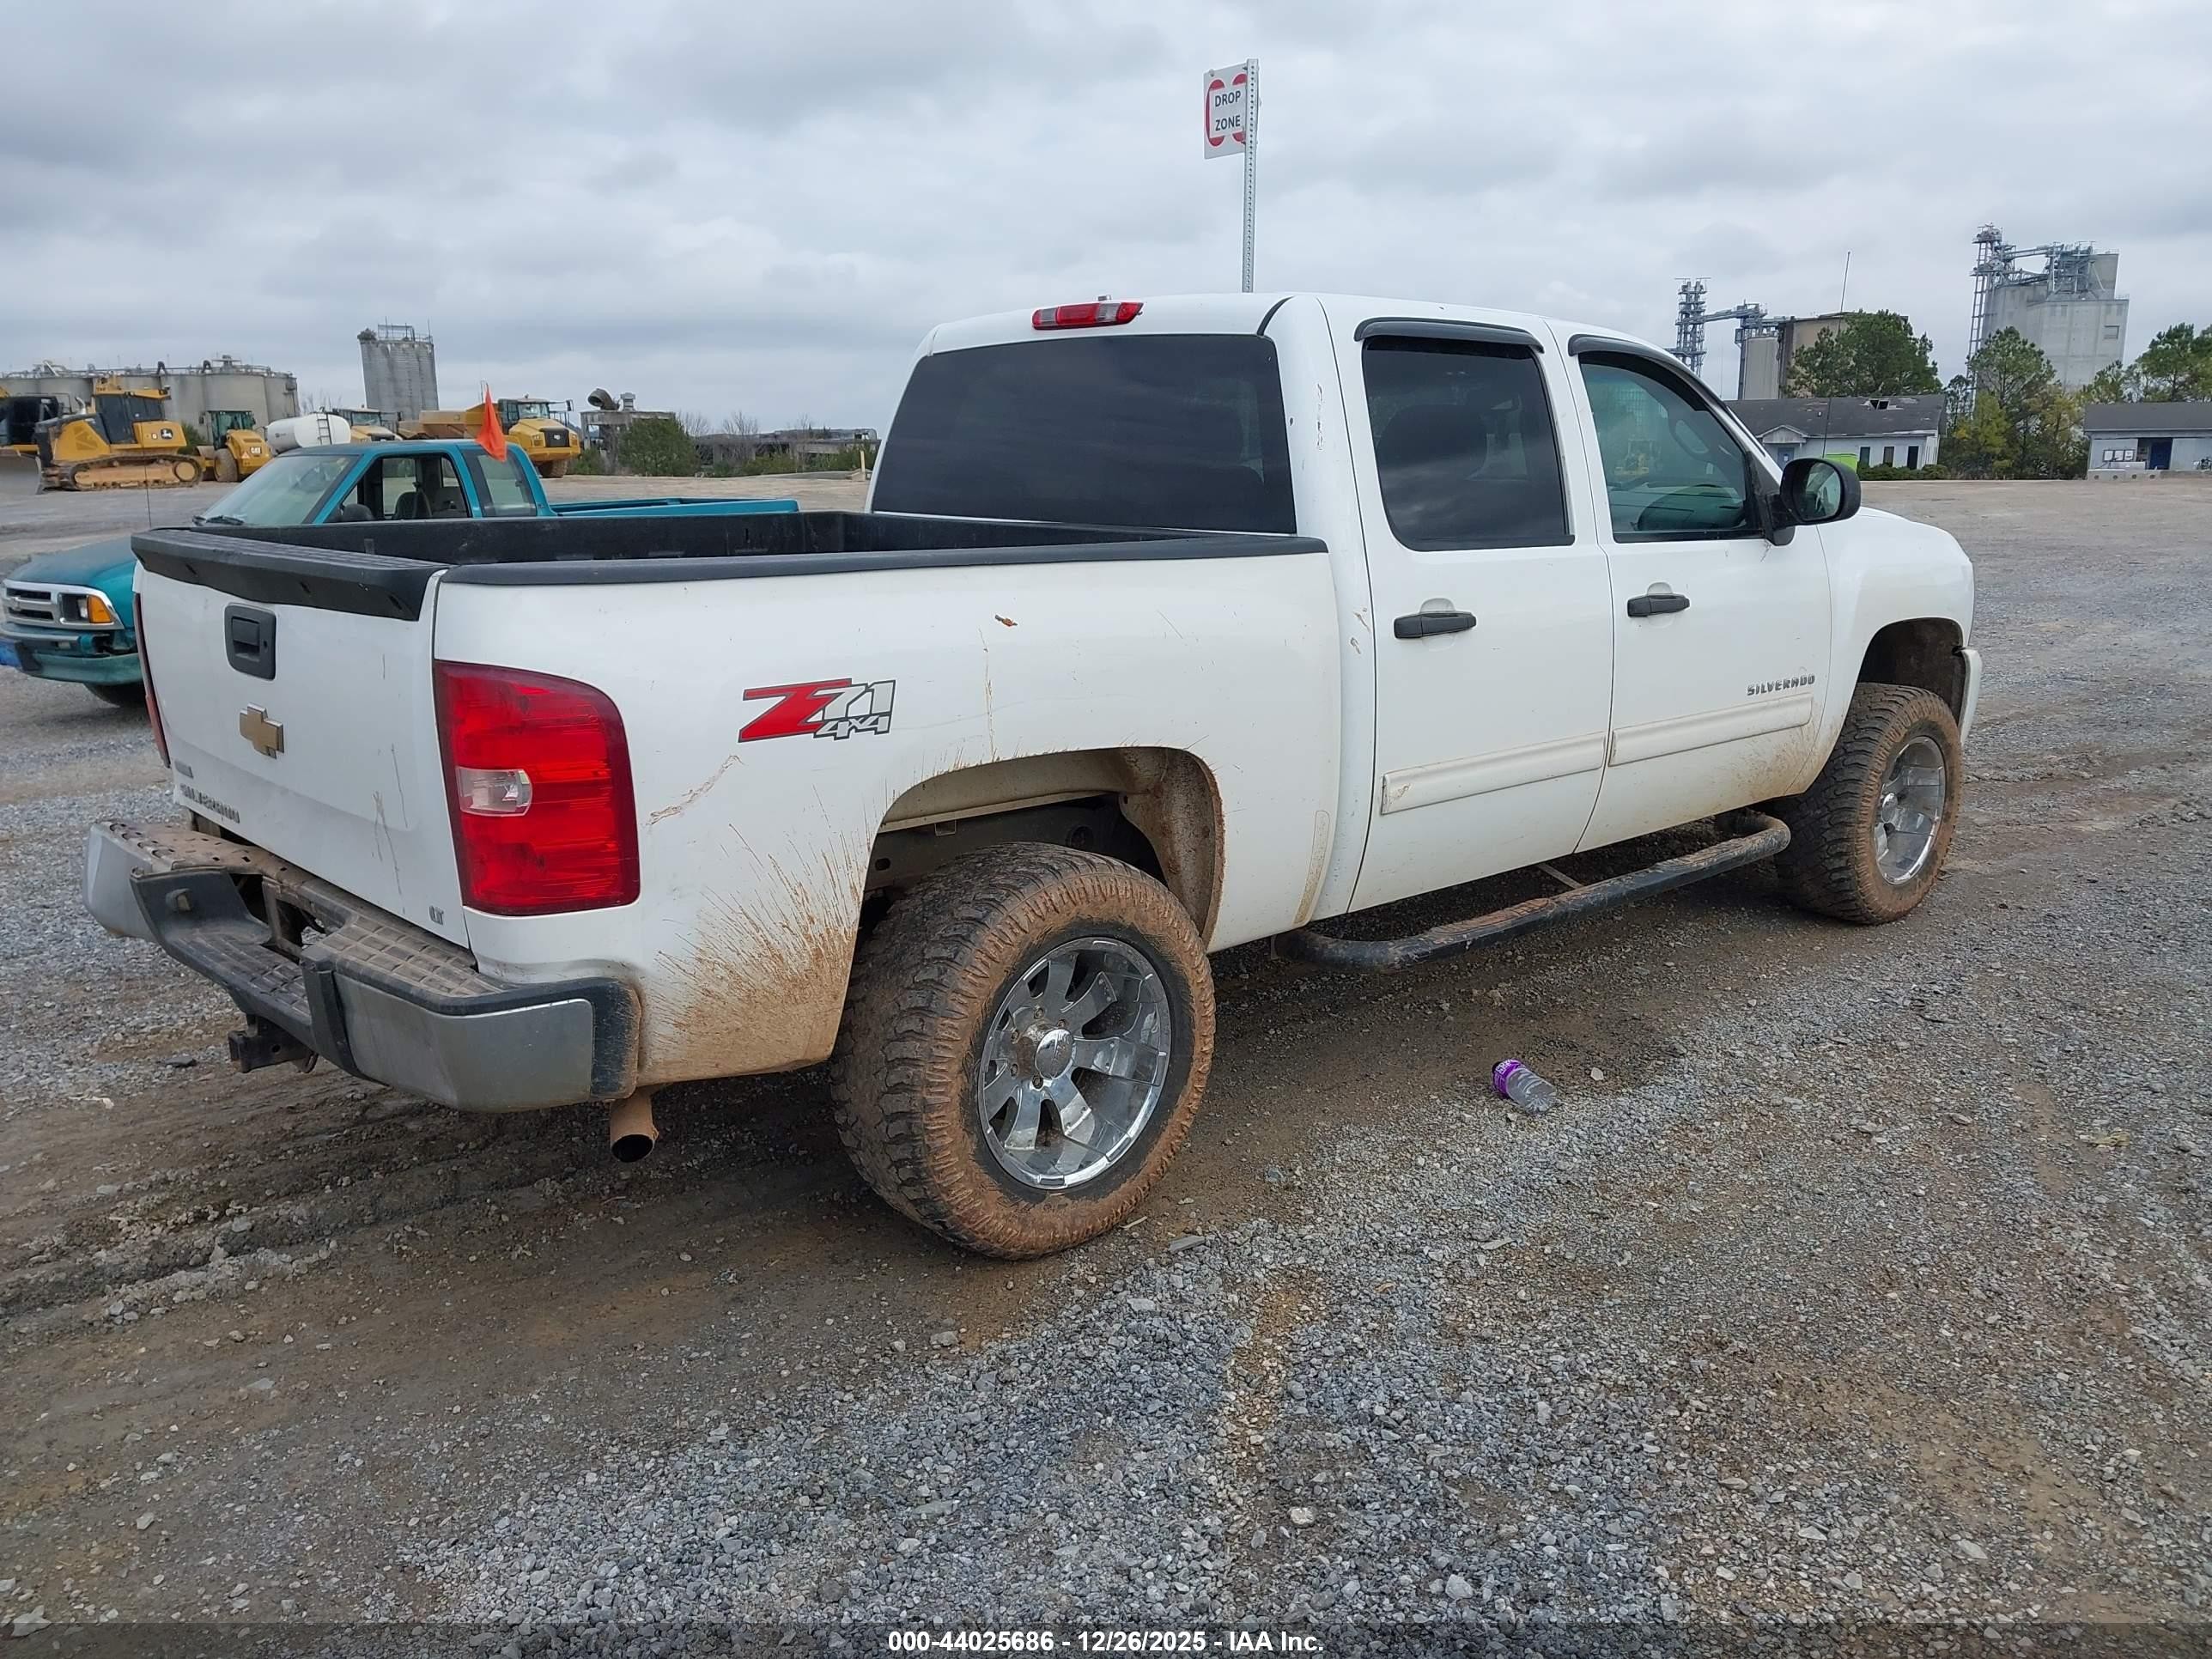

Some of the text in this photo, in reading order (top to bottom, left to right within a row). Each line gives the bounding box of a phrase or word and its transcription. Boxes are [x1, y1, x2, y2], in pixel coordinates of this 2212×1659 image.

[1214, 90, 1242, 107] DROP
[1215, 115, 1241, 131] ZONE
[1747, 675, 1815, 696] SILVERADO
[738, 678, 896, 743] Z71
